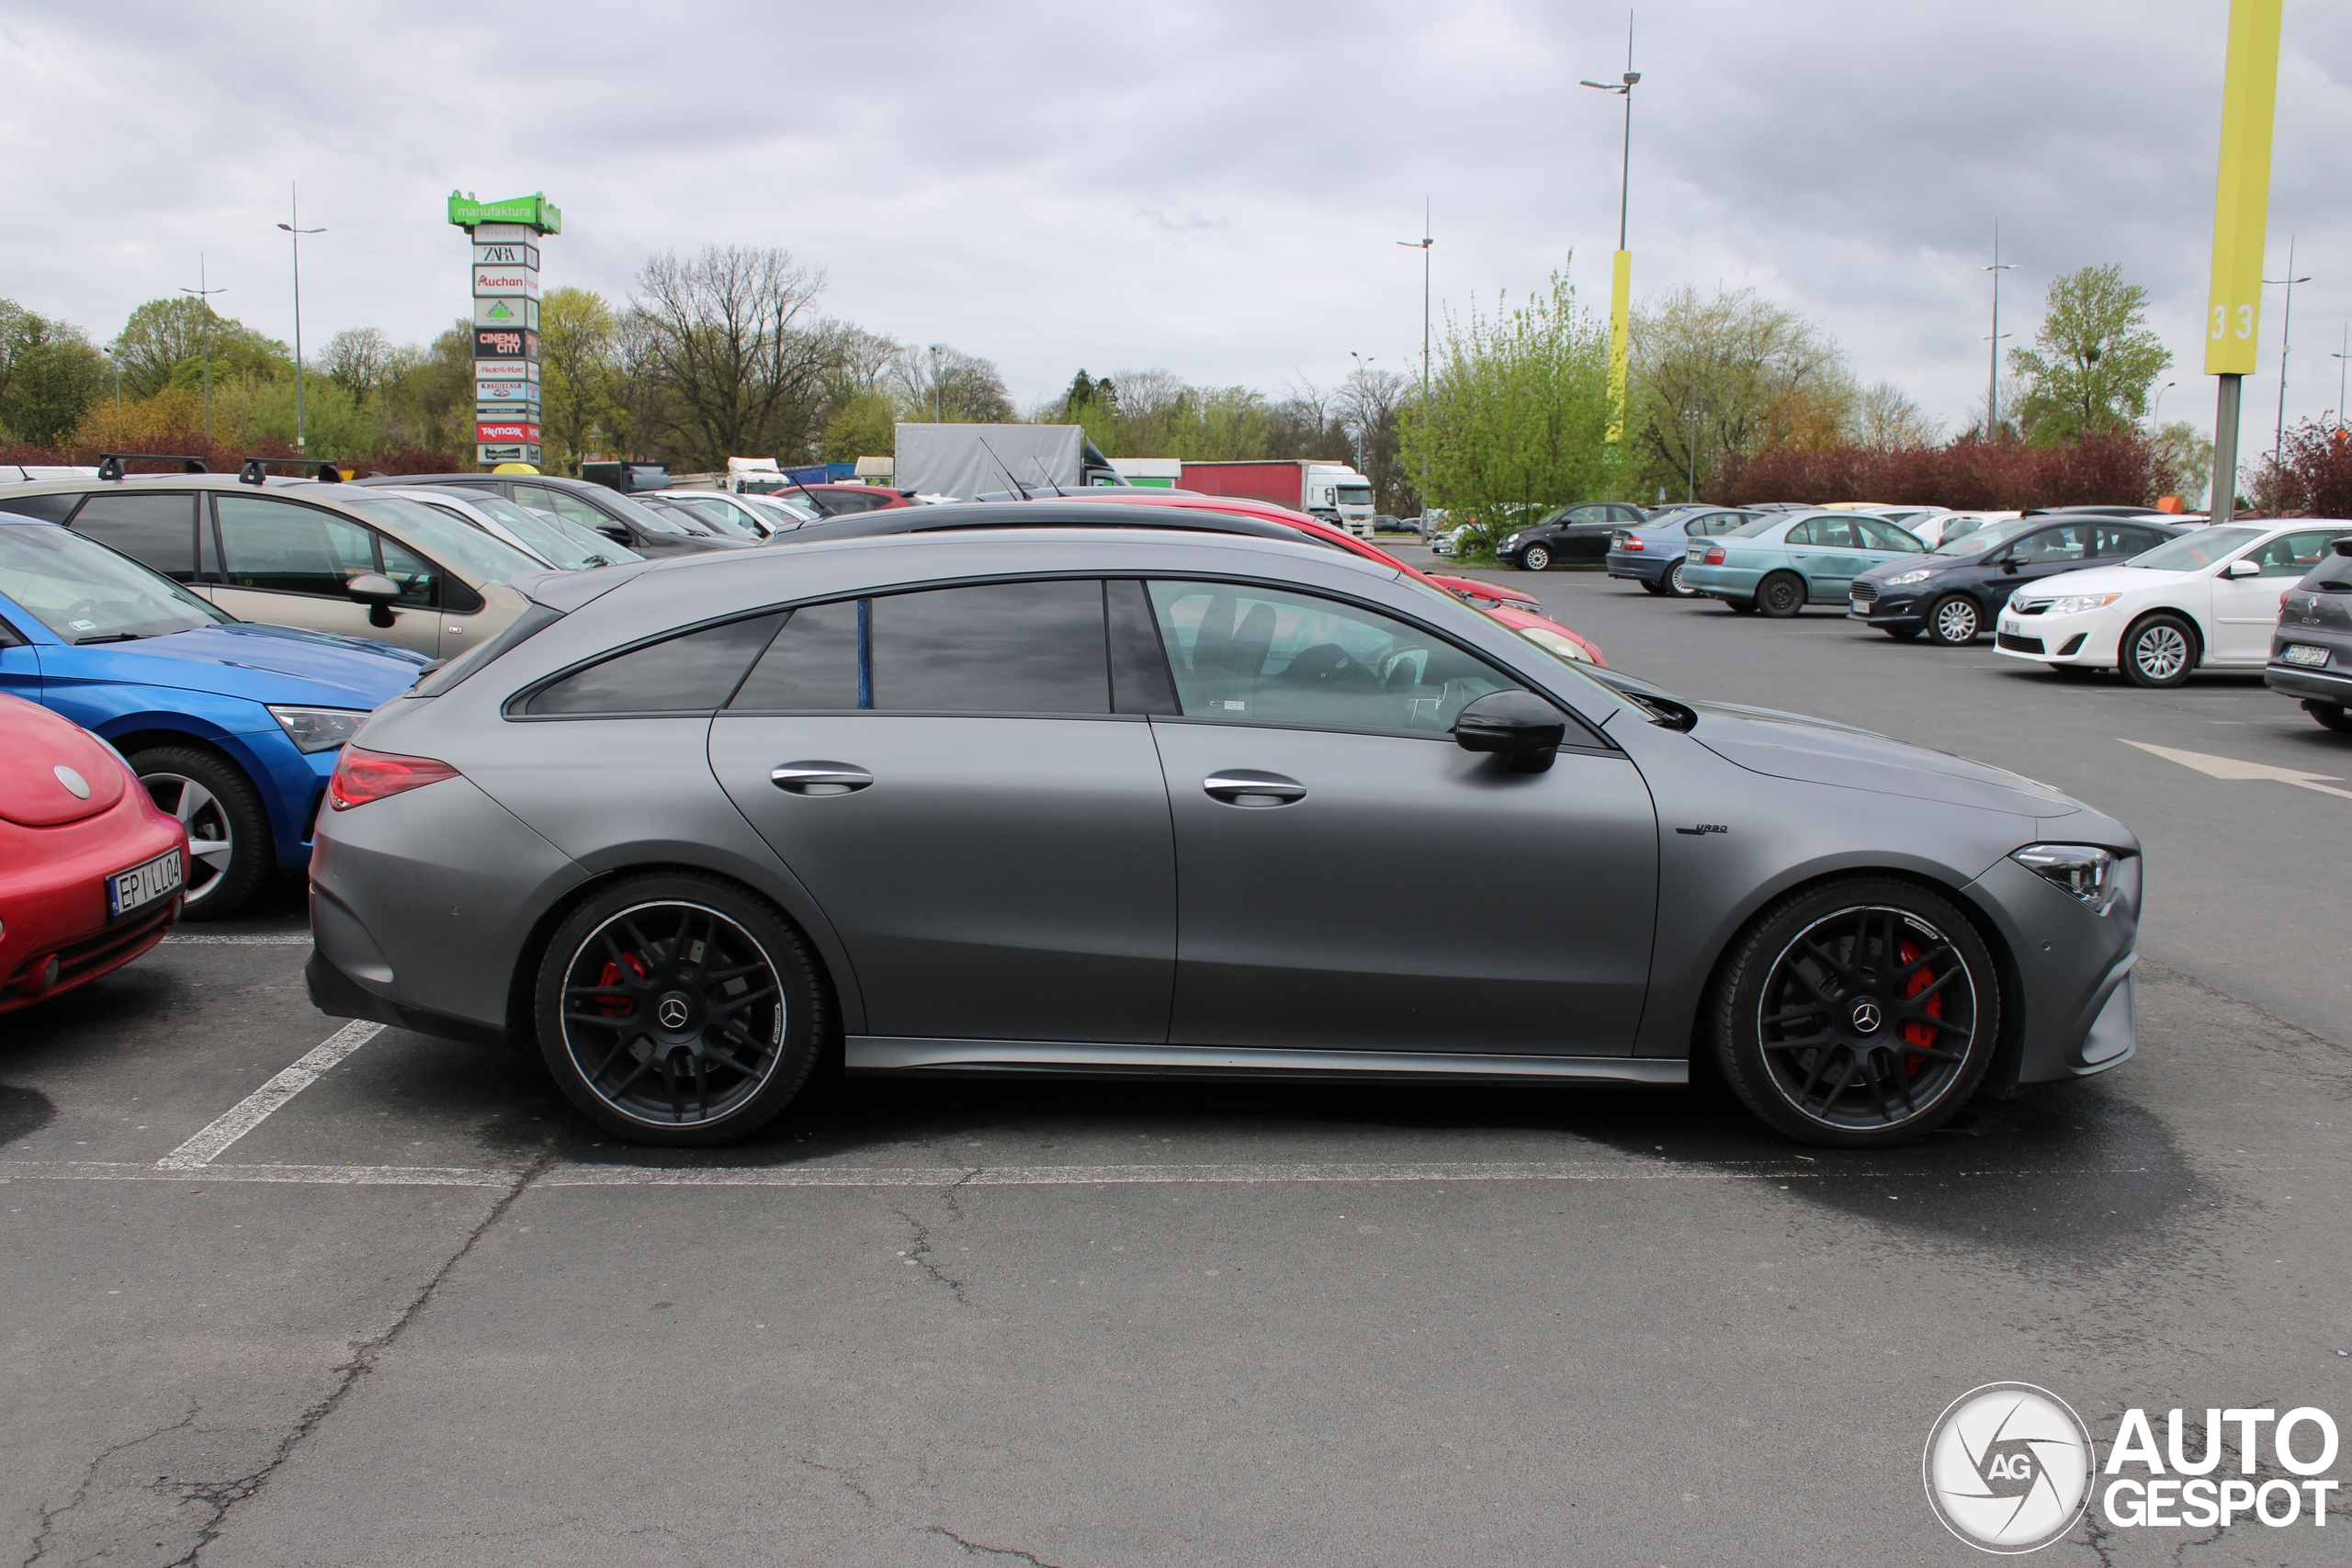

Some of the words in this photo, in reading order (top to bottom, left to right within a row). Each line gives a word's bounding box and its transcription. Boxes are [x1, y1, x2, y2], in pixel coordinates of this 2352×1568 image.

[458, 206, 531, 217] manufaktura
[483, 247, 515, 261] ZARA
[477, 275, 523, 287] Auchan
[485, 302, 500, 318] LEROY
[479, 333, 521, 344] CINEMA
[496, 344, 521, 354] CITY
[2301, 616, 2321, 625] CLIO
